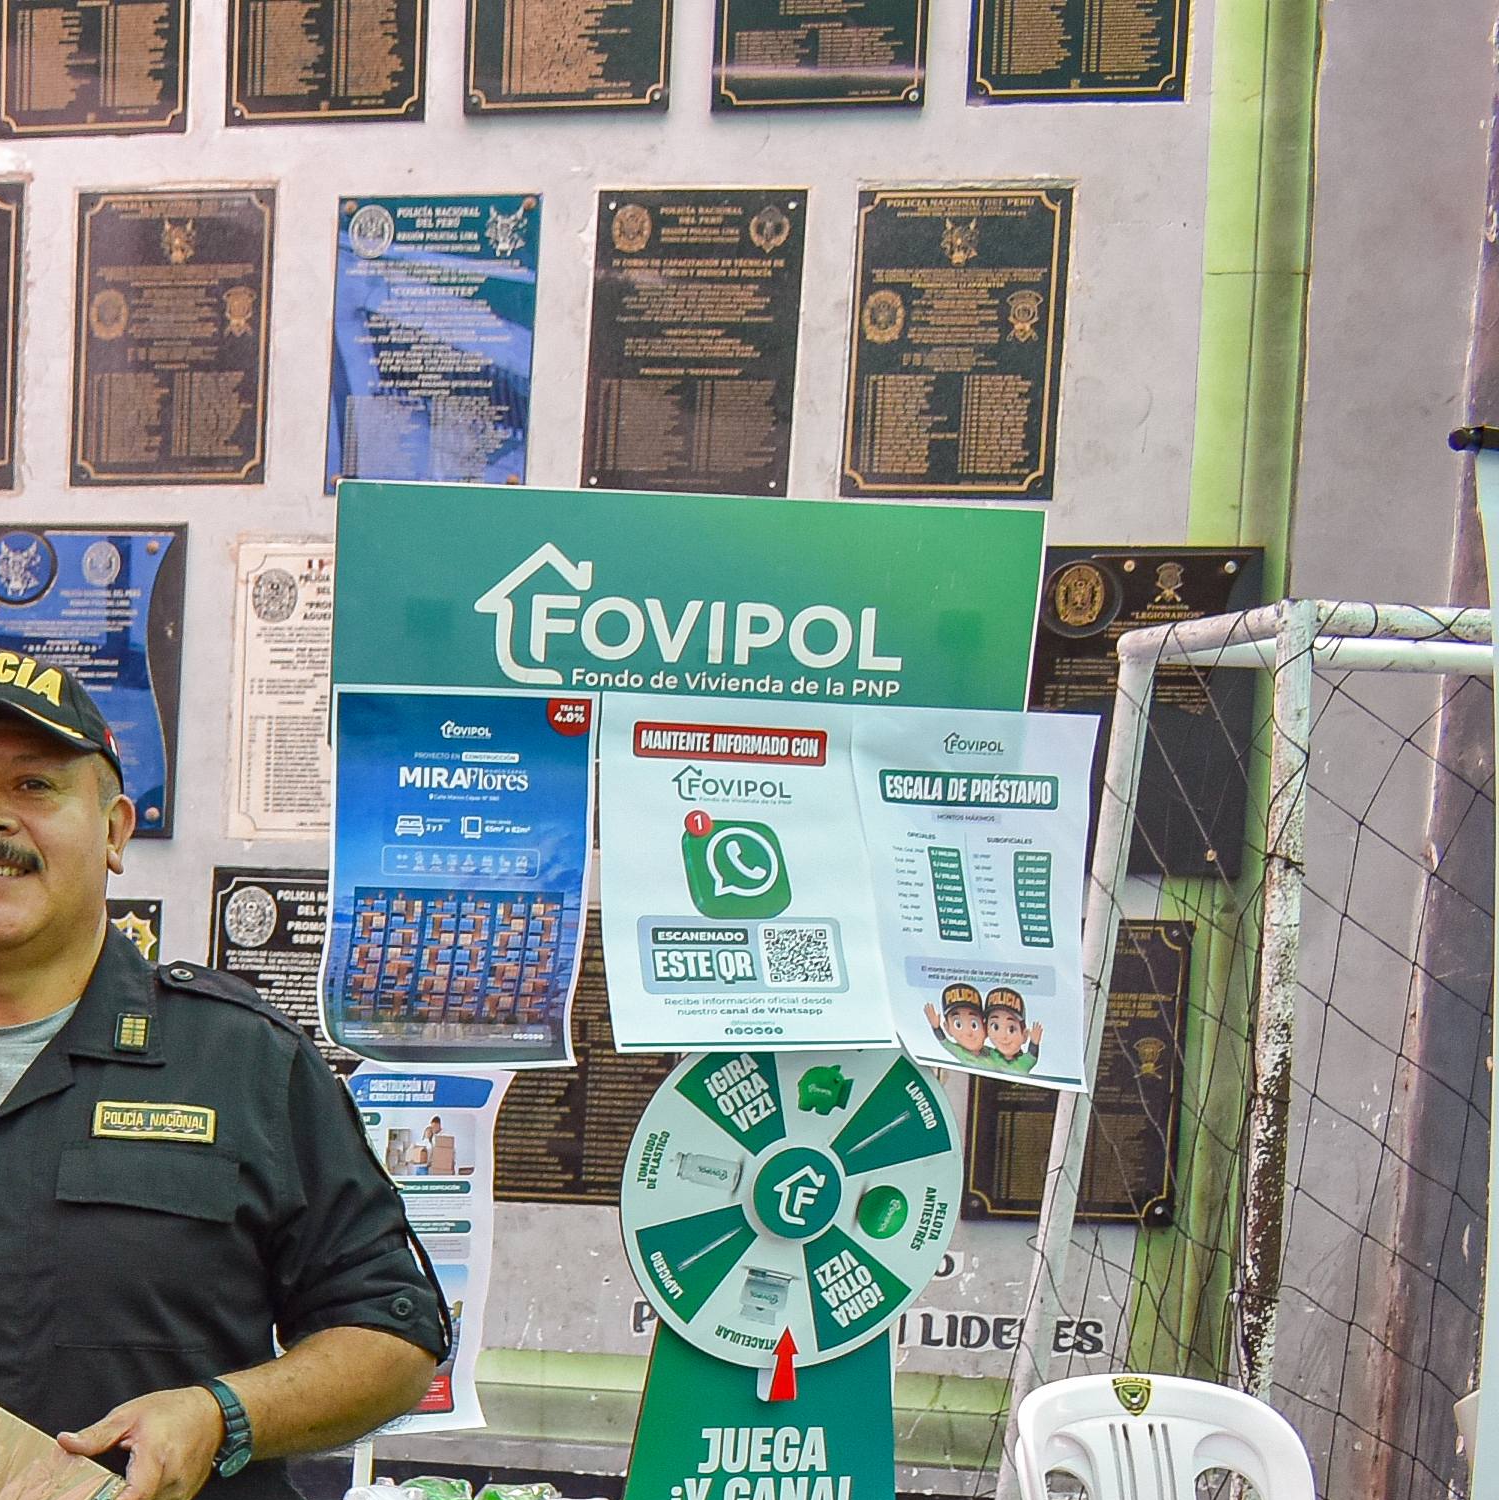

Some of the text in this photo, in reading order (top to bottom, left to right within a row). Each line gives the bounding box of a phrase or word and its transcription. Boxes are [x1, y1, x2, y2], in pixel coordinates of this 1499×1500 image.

[528, 593, 902, 672] FOVIPOL
[570, 666, 901, 698] Fondo de Vivienda de la PNP
[554, 712, 585, 723] 4.0%
[640, 729, 819, 758] MANTENTE INFORMADO CON
[949, 740, 1005, 753] FOVIPOL
[687, 777, 792, 799] FOVIPOL
[885, 774, 1052, 805] ESCALA DE PRÉSTAMO
[694, 814, 703, 831] 1
[657, 931, 745, 942] ESCANENADO
[654, 950, 755, 983] ESTE QR
[664, 996, 833, 1005] Recibe información oficial desde
[677, 1006, 823, 1016] nuestro canal de Whatsapp
[704, 1052, 759, 1098] ¡GIRA
[716, 1072, 769, 1117] OTRA
[905, 1080, 938, 1130] LAPICERO
[103, 1109, 206, 1131] POLICIA NACIONAL
[730, 1097, 777, 1133] VEZ!
[637, 1132, 659, 1184] TOMATODO
[646, 1130, 670, 1190] DE PLASTICO
[910, 1186, 938, 1252] ANTIESTRÉS
[928, 1202, 948, 1242] PELOTA
[651, 1250, 684, 1300] LAPICERO
[812, 1249, 859, 1285] VEZ!
[820, 1264, 873, 1309] OTRA
[830, 1280, 885, 1328] ¡GIRA
[920, 1312, 1103, 1355] LIDEES
[697, 1425, 827, 1474] JUEGA
